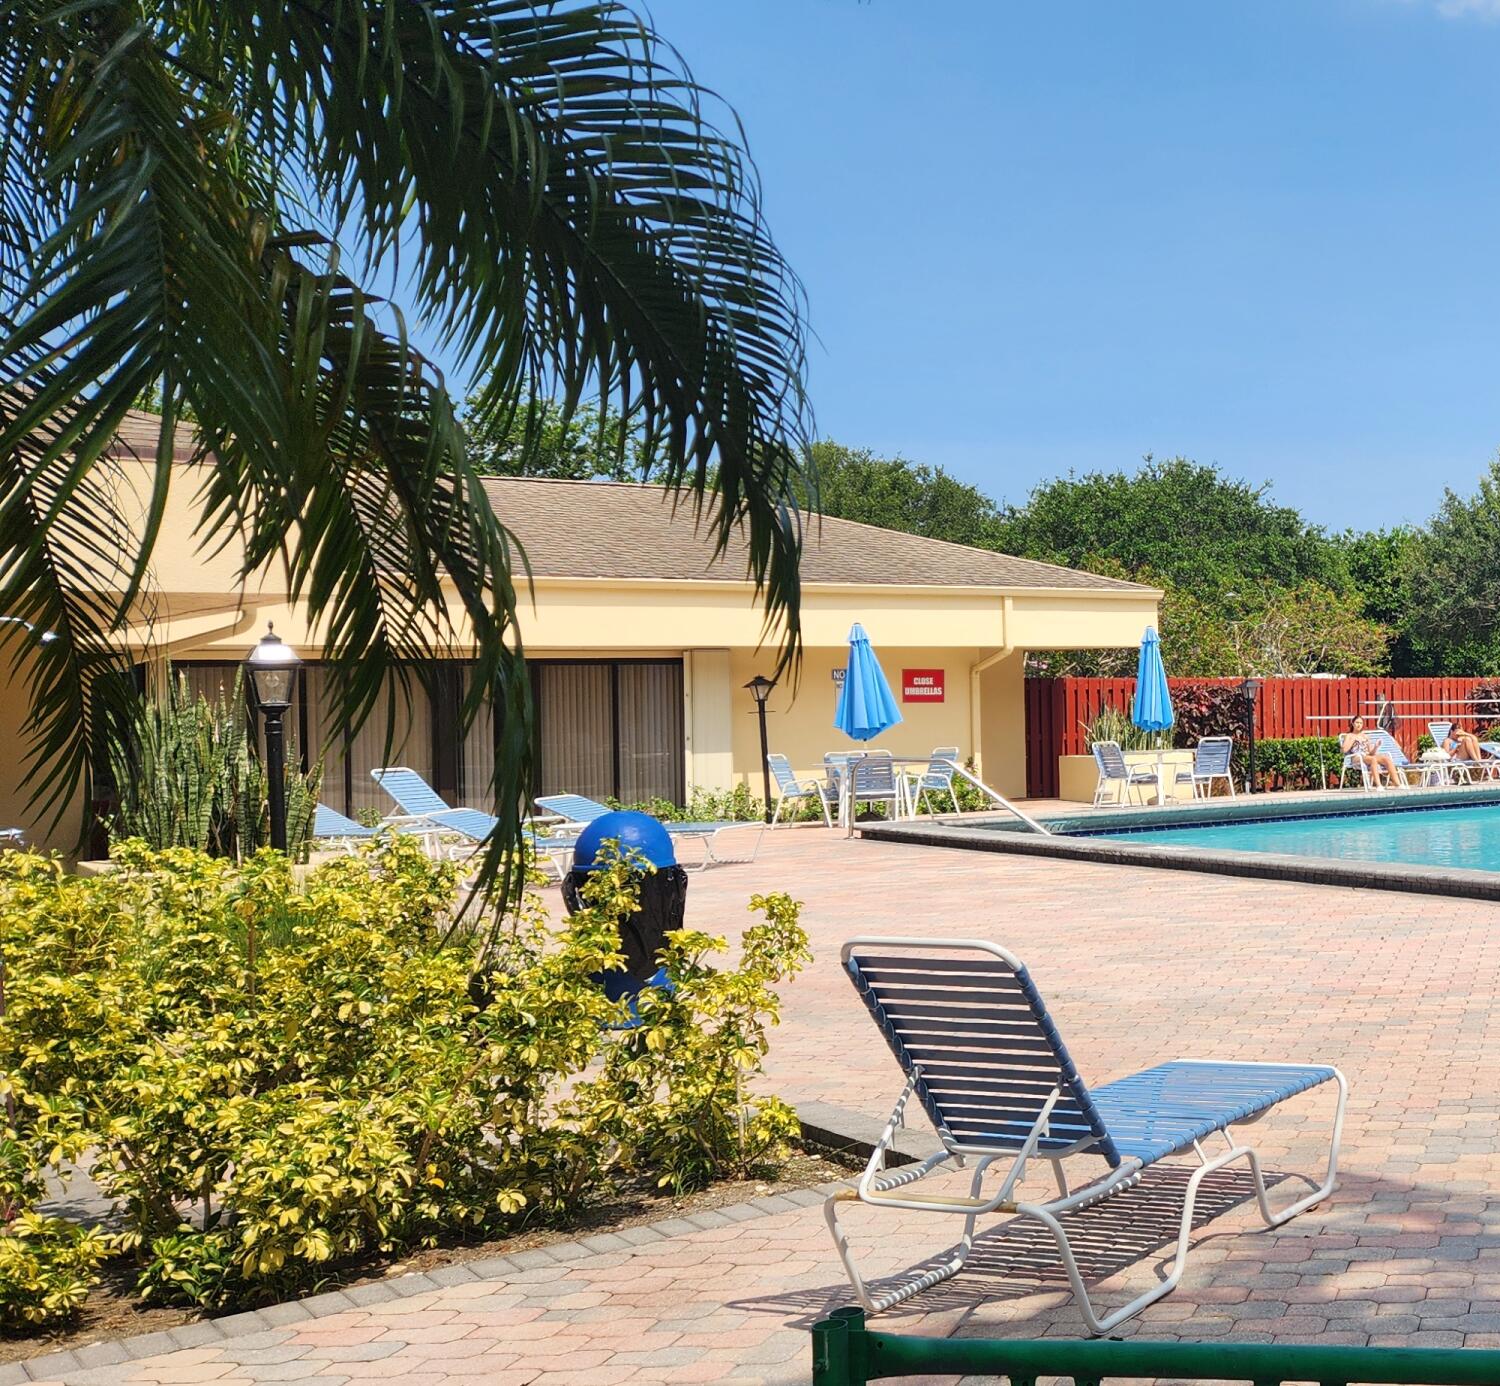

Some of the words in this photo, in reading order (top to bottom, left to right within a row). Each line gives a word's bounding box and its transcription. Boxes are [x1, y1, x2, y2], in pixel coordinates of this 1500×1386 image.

[833, 670, 846, 680] NO
[913, 677, 934, 685] CLOSE
[904, 687, 942, 695] UMBRELLAS
